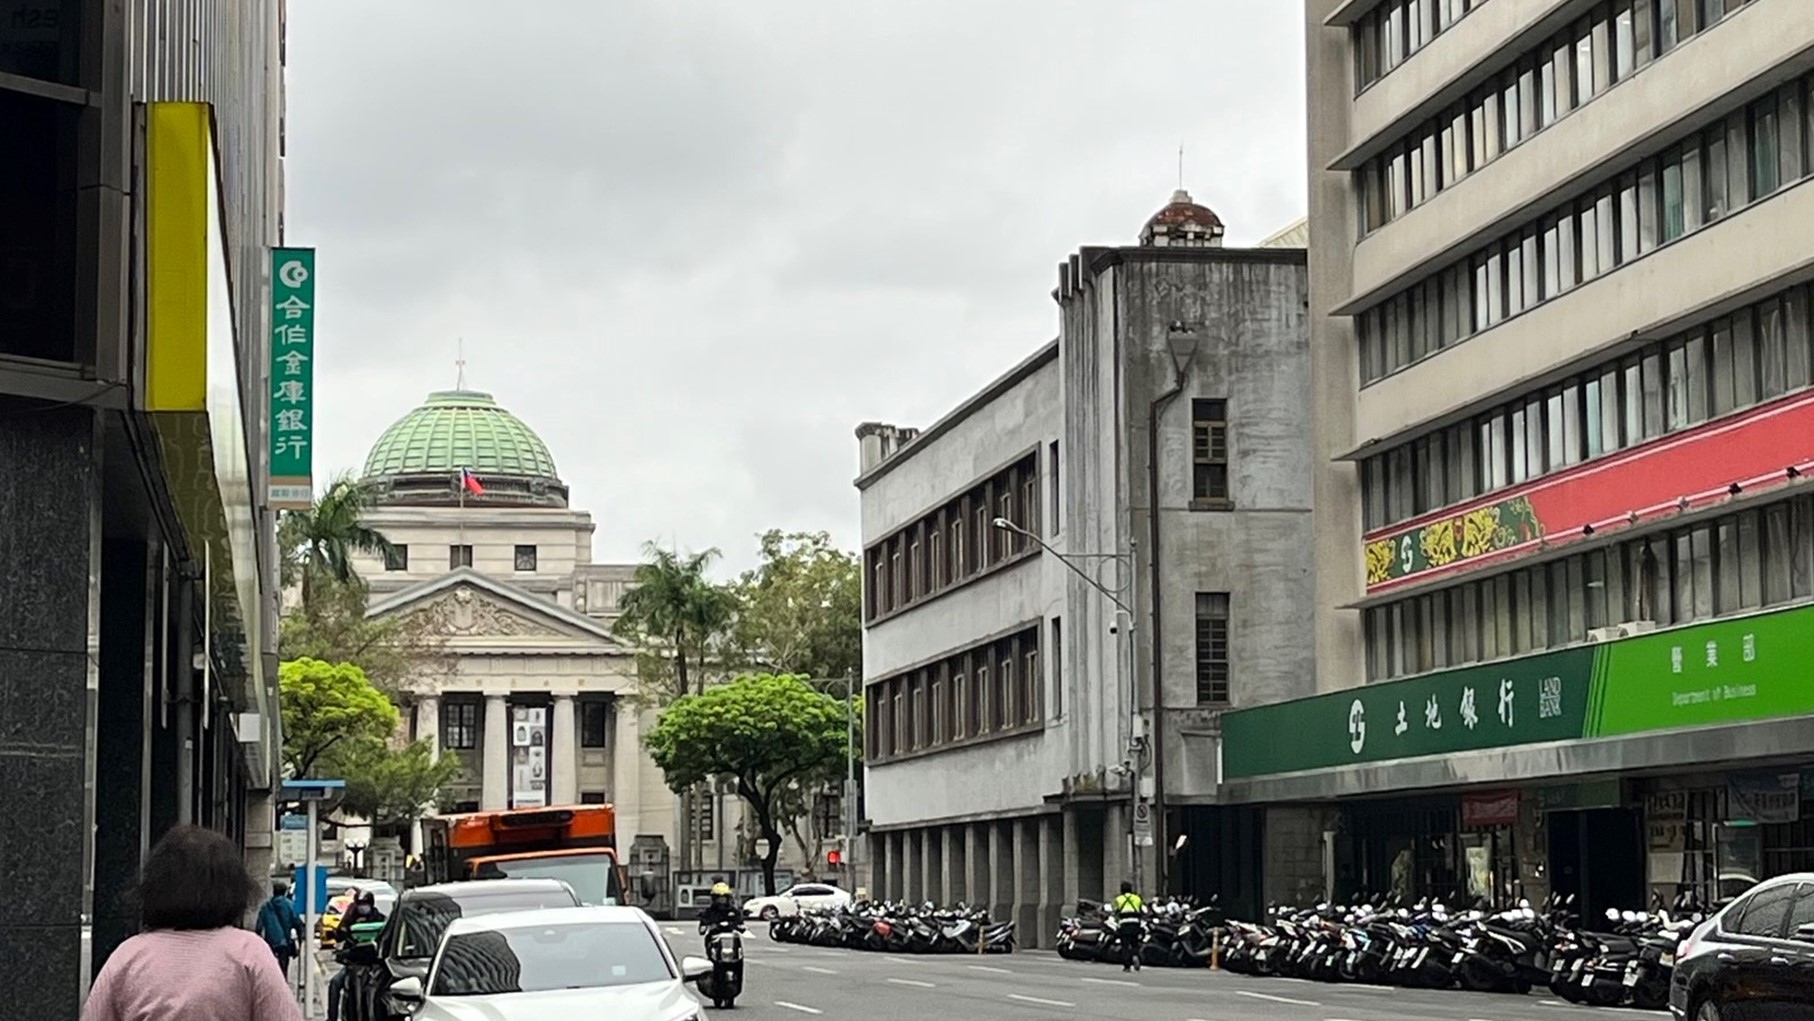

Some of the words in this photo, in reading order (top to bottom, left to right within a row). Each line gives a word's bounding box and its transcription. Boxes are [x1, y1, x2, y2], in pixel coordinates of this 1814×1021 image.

[273, 294, 310, 460] 合作金庫銀行
[1538, 676, 1561, 697] LAND
[1672, 689, 1709, 707] Department
[1712, 686, 1721, 701] of
[1724, 684, 1757, 699] Business
[1394, 678, 1515, 736] 土地銀行
[1539, 696, 1562, 718] BANK
